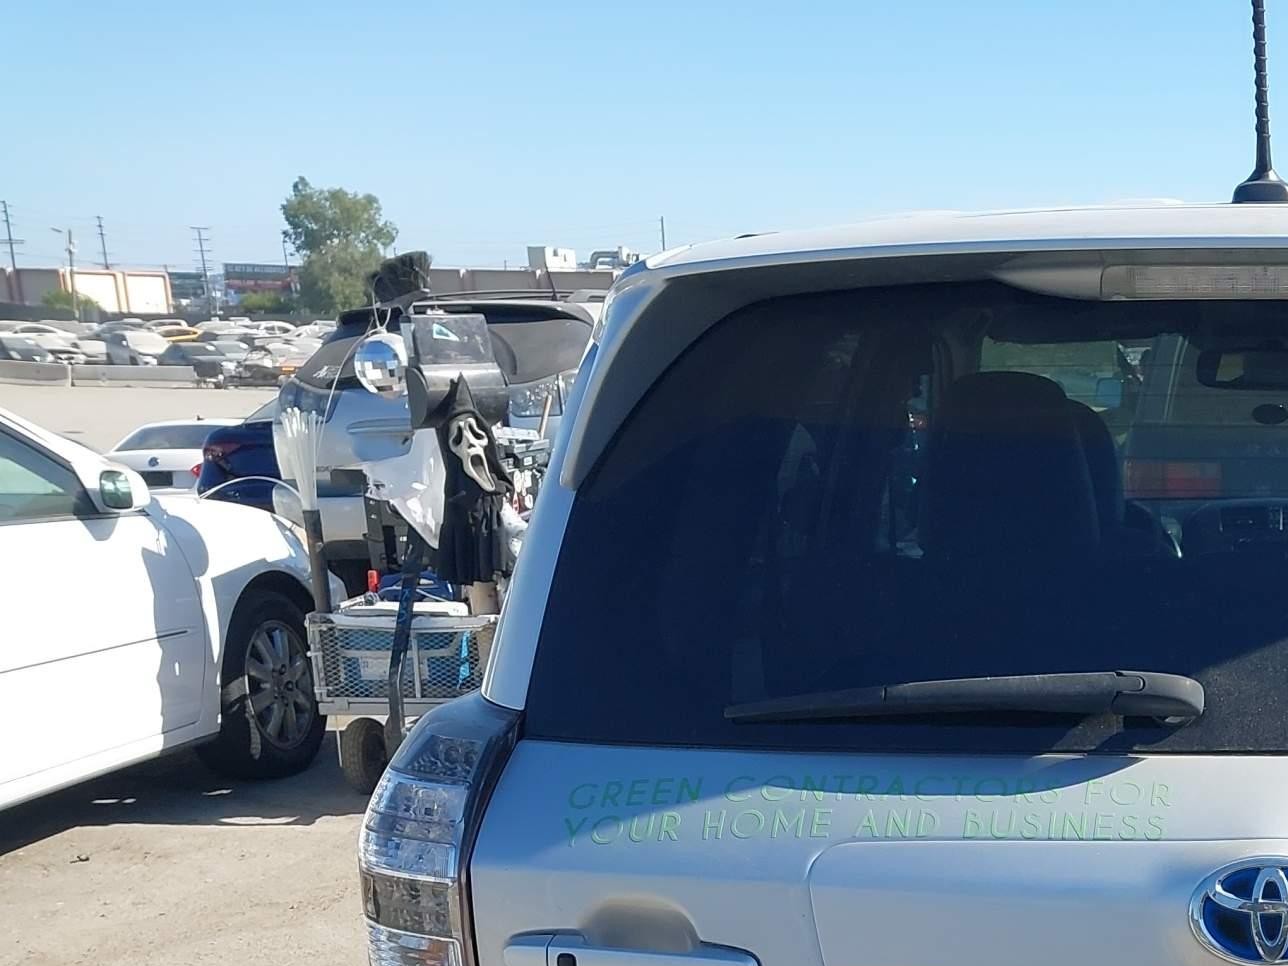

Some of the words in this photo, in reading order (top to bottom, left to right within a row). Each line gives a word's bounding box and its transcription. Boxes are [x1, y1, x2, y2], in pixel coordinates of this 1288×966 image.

[567, 777, 702, 810] GREEN
[722, 774, 1066, 806] CONTRACTORS
[1083, 778, 1172, 808] FOR
[562, 810, 683, 848] YOUR
[701, 807, 834, 842] HOME
[853, 808, 940, 840] AND
[962, 808, 1169, 841] BUSINESS
